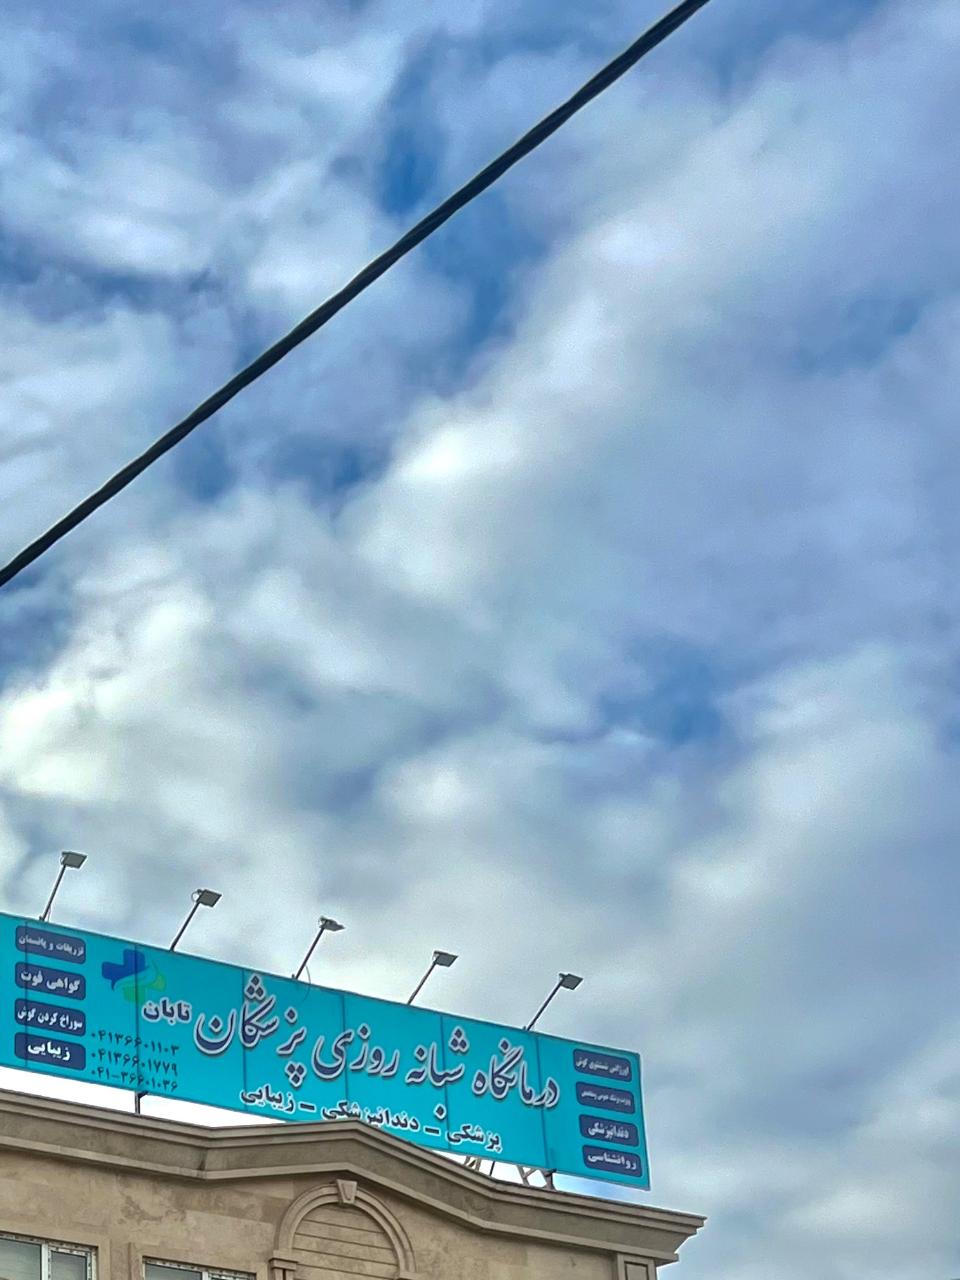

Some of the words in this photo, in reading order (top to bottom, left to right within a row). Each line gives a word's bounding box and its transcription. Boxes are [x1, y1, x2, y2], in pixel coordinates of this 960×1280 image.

[20, 970, 43, 987] فوت
[46, 976, 81, 994] گواهی
[17, 1006, 37, 1021] گوش
[38, 1011, 58, 1027] کردن
[141, 996, 192, 1026] تابان
[60, 1015, 83, 1031] سوراخ
[193, 971, 307, 1088] پزشکان
[27, 1041, 71, 1061] زیبایی
[311, 1023, 400, 1080] روزی
[405, 1025, 469, 1121] شبانه
[471, 1037, 561, 1108] درمانگاه
[240, 1084, 296, 1113] زیبایی
[446, 1123, 503, 1152] پزشکی
[587, 1122, 629, 1140] دندانپزشکی
[587, 1151, 637, 1170] روانشناسی
